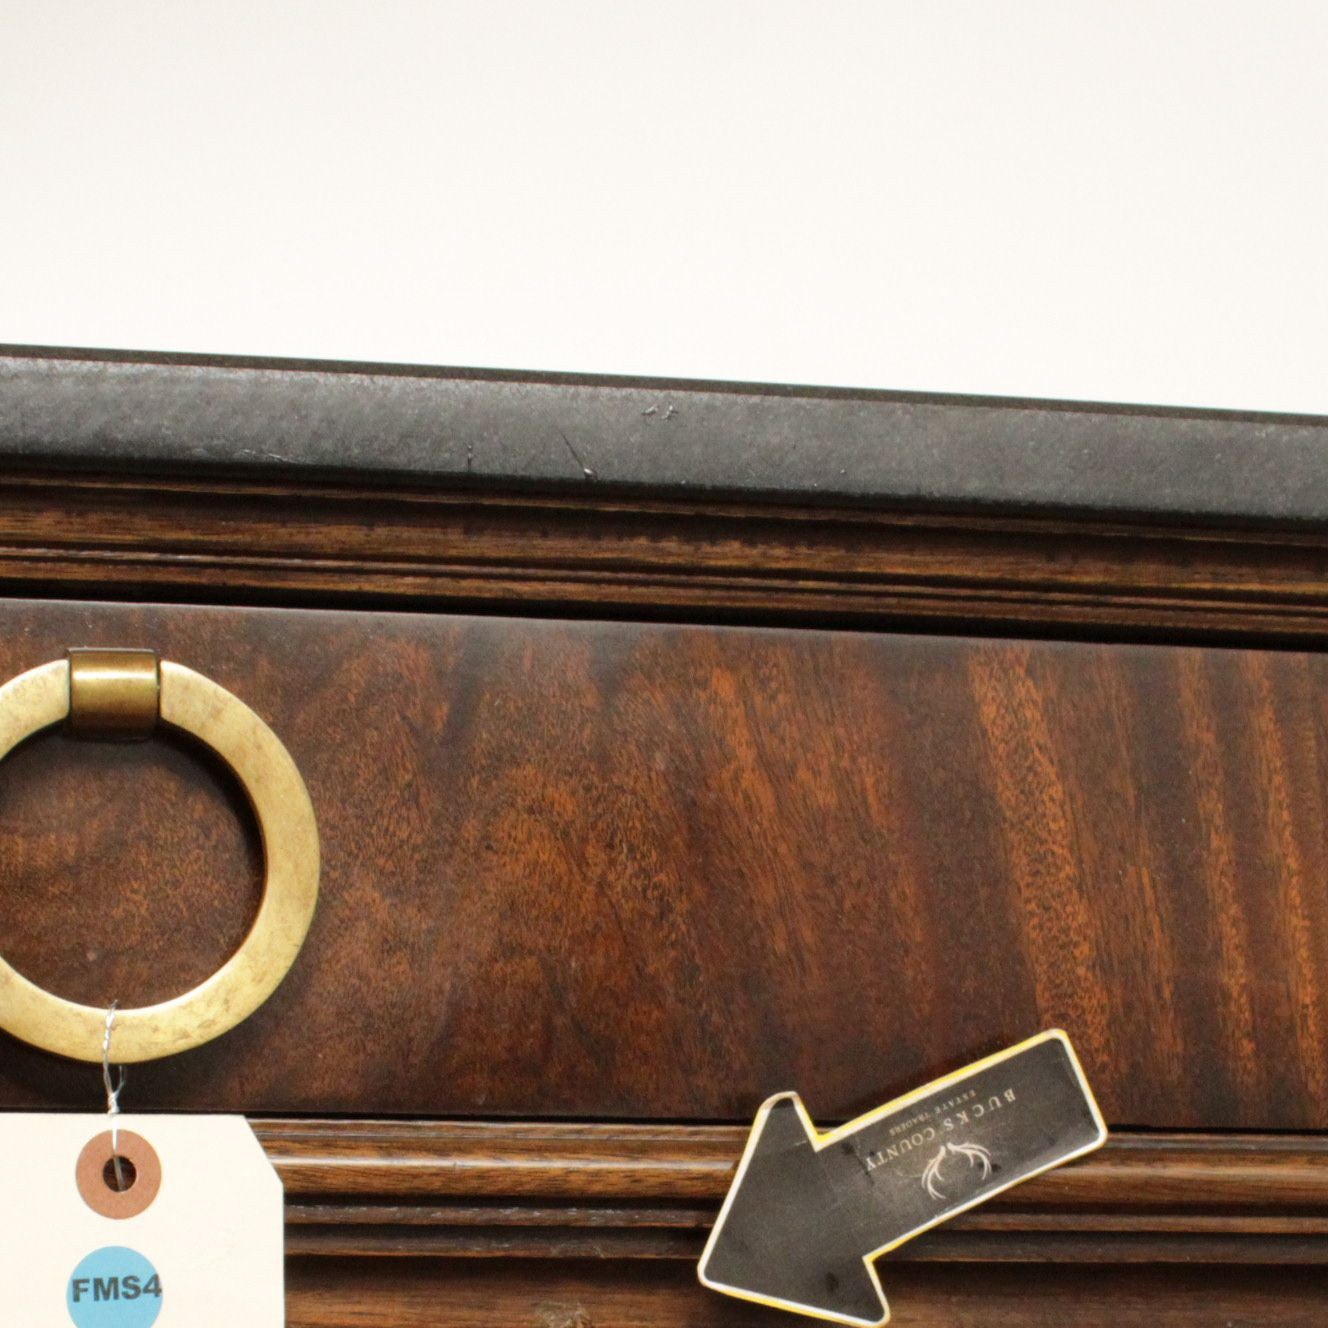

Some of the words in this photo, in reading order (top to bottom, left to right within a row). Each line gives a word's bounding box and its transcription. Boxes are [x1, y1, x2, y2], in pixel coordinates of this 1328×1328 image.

[943, 1088, 1016, 1132] BUCKS
[865, 1129, 936, 1172] COUNTY
[72, 1274, 162, 1303] FMS4
